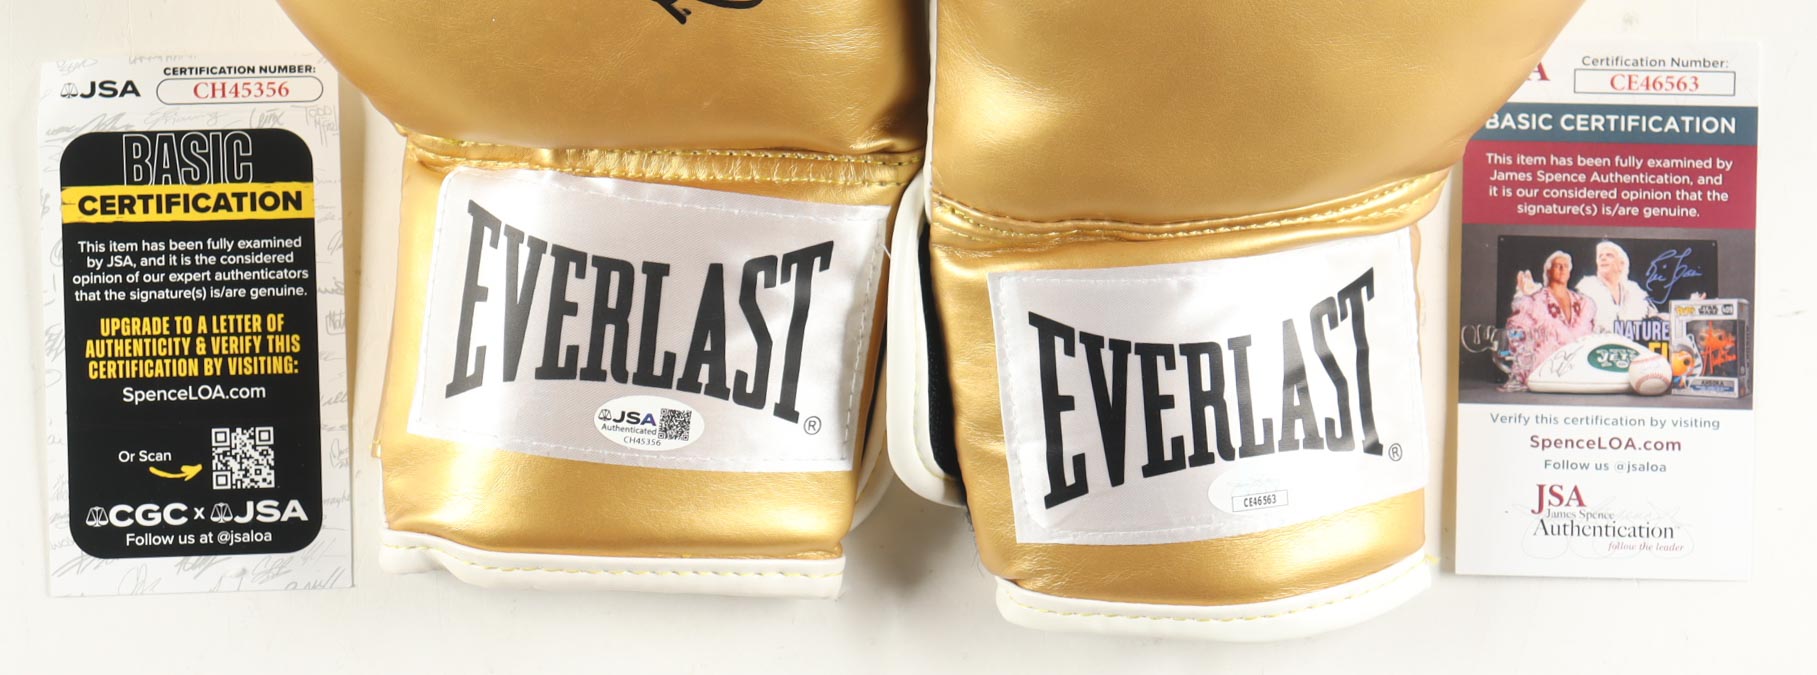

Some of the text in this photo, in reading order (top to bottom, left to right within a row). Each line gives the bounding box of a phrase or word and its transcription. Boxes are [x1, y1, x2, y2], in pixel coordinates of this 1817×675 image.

[163, 65, 316, 76] CERTIFICATION NUMBER:
[1582, 56, 1729, 68] Certification Number:
[80, 80, 141, 98] JSA
[193, 81, 289, 99] CH45356
[1610, 74, 1700, 92] CE46563
[1486, 113, 1736, 134] BASIC CERTIFICATION
[123, 131, 253, 186] BASIC
[1486, 153, 1733, 171] This item has been fully examined by
[1490, 170, 1722, 186] James Spence Authentication, and
[1489, 186, 1728, 202] it is our considered opinion that the
[78, 191, 303, 216] CERTIFICATION
[1517, 202, 1700, 218] signature(s) is/are genuine.
[78, 237, 301, 253] This item has been fully examined
[87, 252, 293, 269] by JSA, and it is the considered
[72, 268, 308, 286] opinion of our expert authenticators
[75, 285, 307, 302] that the signature(s) is/are genuine.
[445, 199, 834, 424] EVERLAST
[100, 313, 284, 336] UPGRADE TO A LETTER OF
[1614, 320, 1670, 341] NATURE
[85, 334, 301, 358] AUTHENTICITY & VERIFY THIS
[89, 355, 299, 379] CERTIFICATION BY VISITING:
[122, 385, 266, 405] SpenceLOA.com
[1028, 266, 1384, 510] EVERLAST
[613, 410, 657, 426] JSA
[1490, 412, 1720, 430] Verify this certification by visiting
[601, 424, 657, 435] Authenticated
[623, 436, 661, 446] CH45356
[1529, 435, 1682, 452] SpenceLOA.com
[118, 450, 172, 463] Or Scan
[1544, 460, 1667, 474] Follow us @jsaloa
[1244, 494, 1277, 507] CE46563
[1531, 484, 1587, 514] JSA
[108, 502, 188, 527] CGC
[194, 508, 205, 520] x
[234, 499, 309, 523] JSA
[1546, 509, 1615, 521] James Spence
[126, 530, 272, 546] Follow us at @jsaloa
[1533, 519, 1674, 539] Authentication
[1608, 542, 1684, 551] follow the leader
